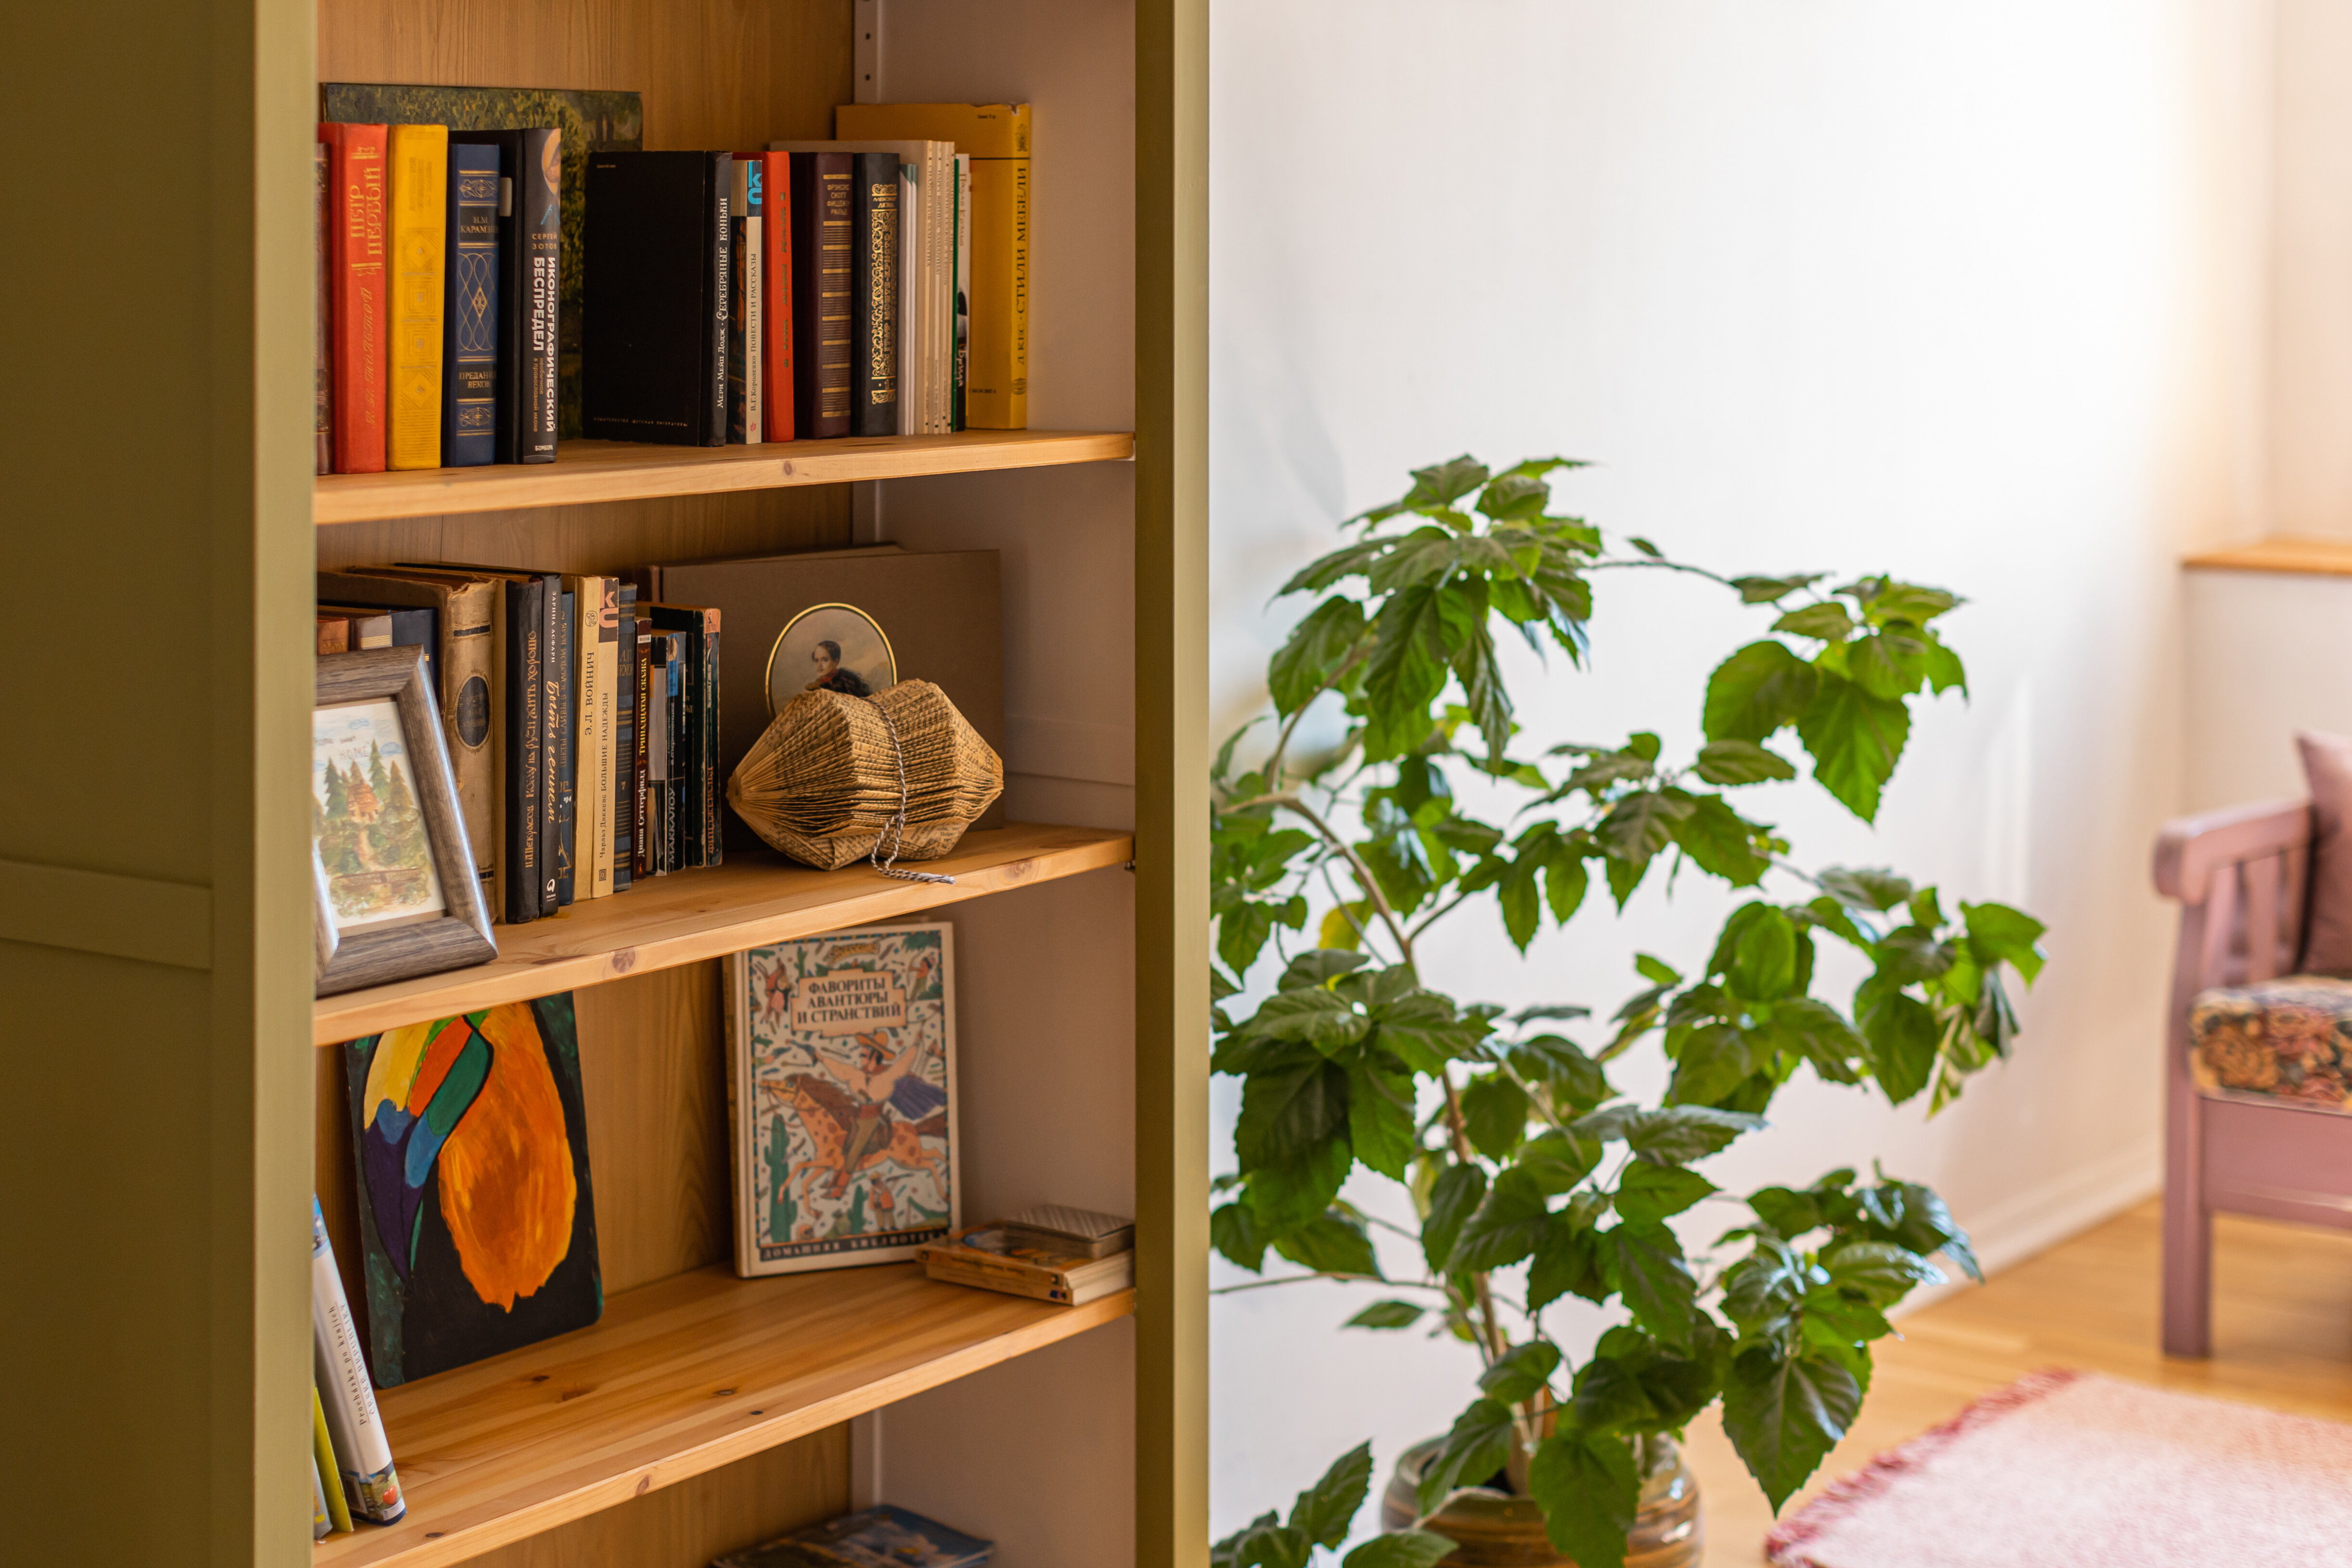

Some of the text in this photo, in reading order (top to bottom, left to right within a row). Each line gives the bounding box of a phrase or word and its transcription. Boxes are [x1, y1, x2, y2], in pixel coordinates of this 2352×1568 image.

[363, 166, 382, 256] ПЕРВЫЙ
[1017, 168, 1026, 241] МЕБЕЛИ
[531, 257, 545, 351] БЕСПРЕДЕЛ
[1017, 249, 1025, 313] СТИЛИ
[547, 257, 556, 432] ИКОНОГРАФИЧЕСКИЙ
[467, 380, 491, 389] ВЕКОВ
[585, 651, 594, 706] ВОЙНИЧ
[548, 745, 556, 824] гением
[621, 781, 626, 790] 7
[797, 1002, 901, 1024] И СТРАНСТВИЙ
[808, 991, 888, 1009] АВАНТЮРЫ
[809, 978, 885, 994] ФАВОРИТЫ
